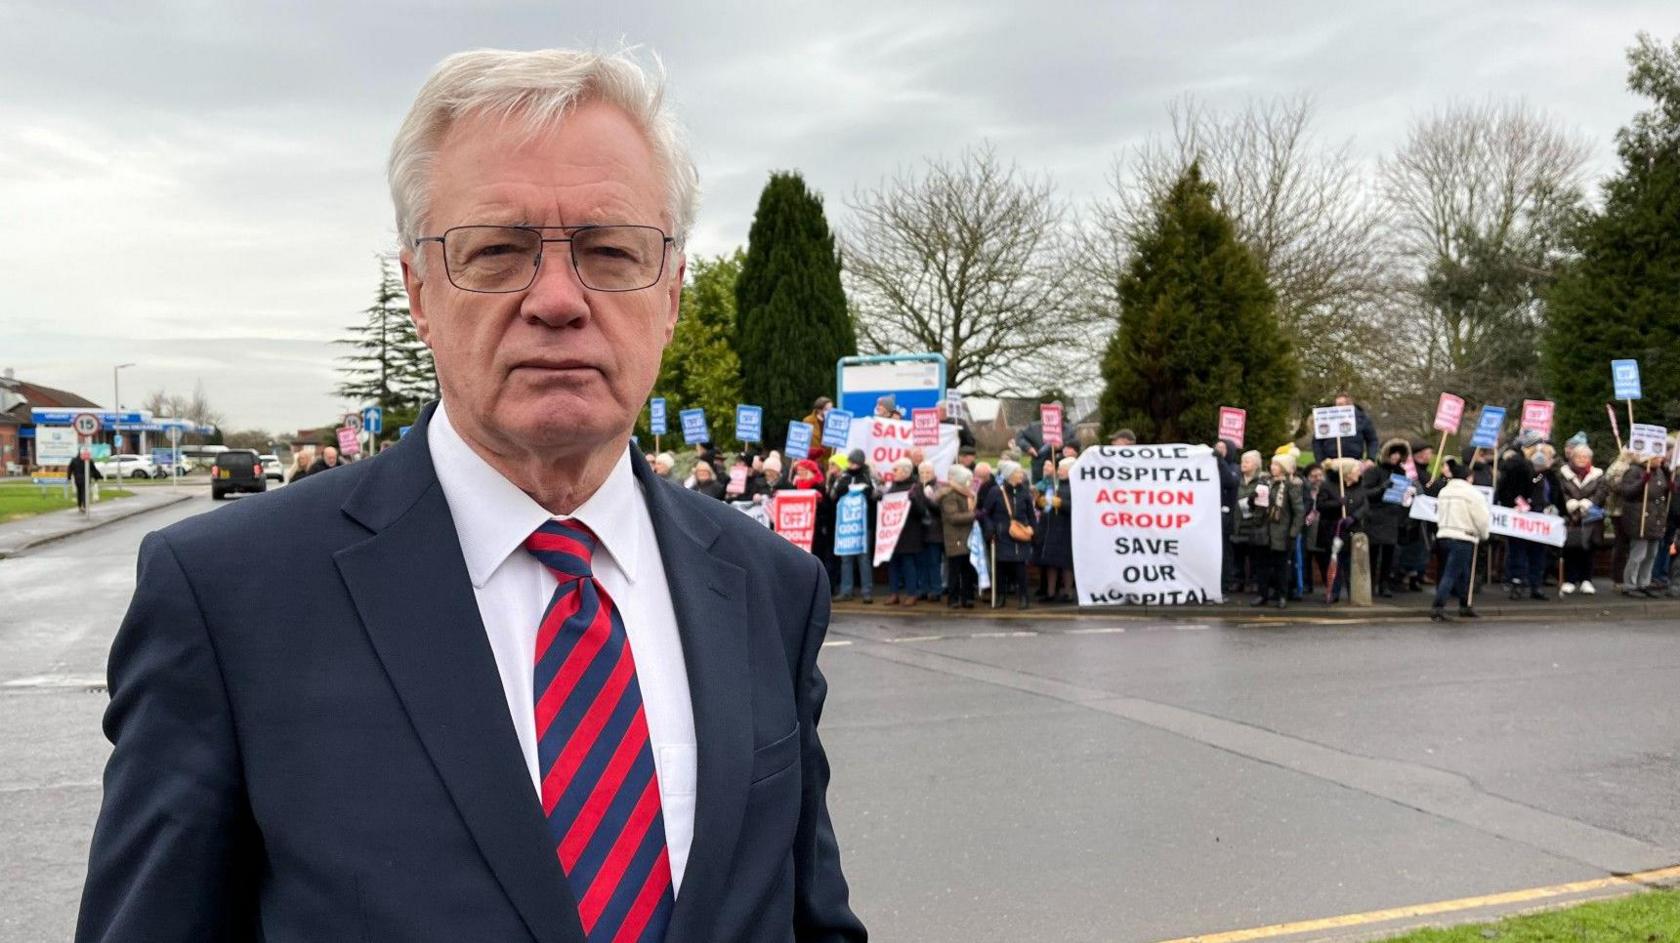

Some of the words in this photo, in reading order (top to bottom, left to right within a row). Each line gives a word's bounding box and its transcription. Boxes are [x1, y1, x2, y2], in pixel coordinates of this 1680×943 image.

[79, 418, 94, 430] 15
[872, 422, 912, 439] SAV
[873, 447, 901, 463] OU
[1099, 447, 1189, 459] GOOLE
[1080, 466, 1210, 482] HOSPITAL
[1096, 489, 1194, 505] ACTION
[1101, 512, 1191, 529] GROUP
[1492, 513, 1508, 527] HE
[1512, 517, 1552, 536] TRUTH
[1115, 537, 1179, 555] SAVE
[1123, 565, 1176, 583] OUR
